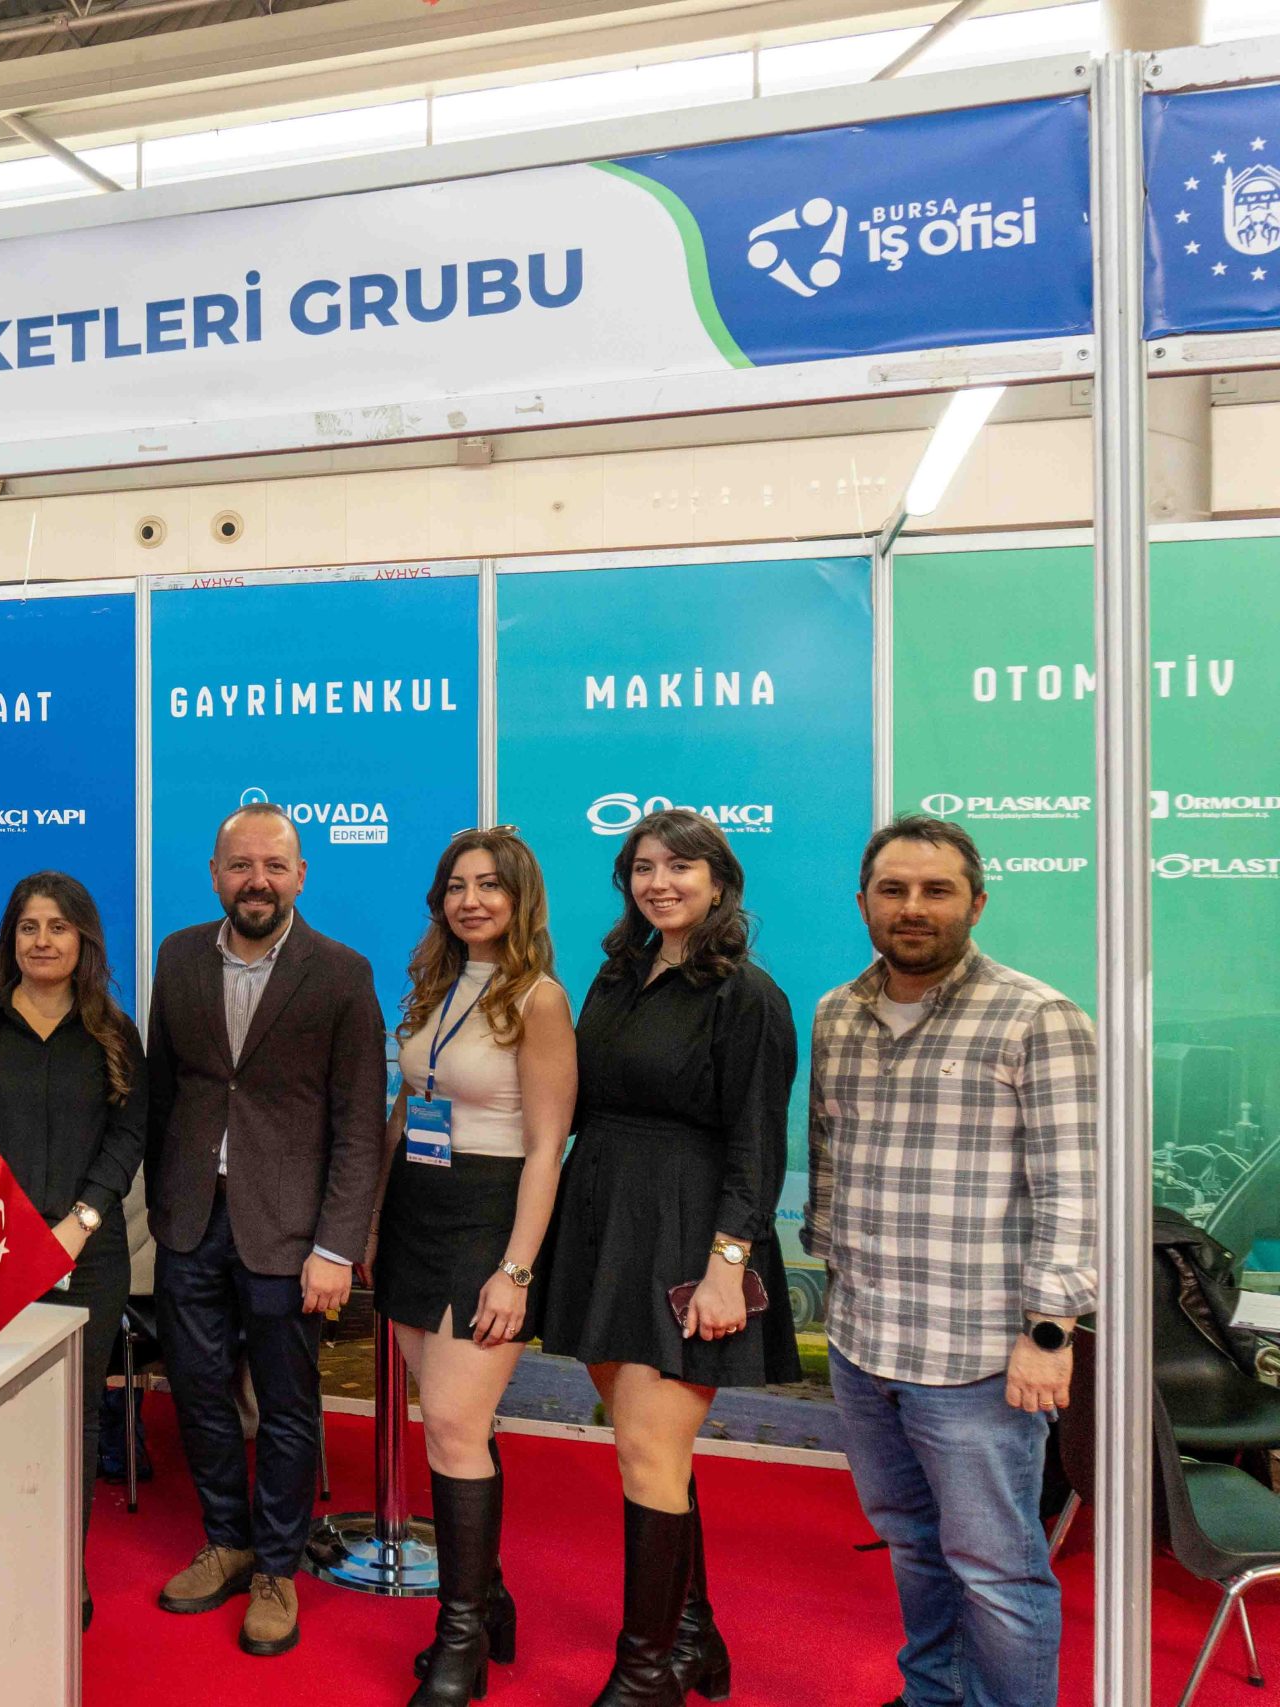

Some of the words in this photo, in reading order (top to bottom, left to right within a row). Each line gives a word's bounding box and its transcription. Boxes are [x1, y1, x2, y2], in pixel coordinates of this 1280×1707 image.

[873, 198, 957, 223] BURSA
[919, 197, 1036, 256] ofisi
[289, 247, 584, 336] GRUBU
[375, 567, 431, 580] SARAY
[586, 667, 774, 709] MAKİNA
[973, 654, 1234, 701] OTOMTİV
[170, 678, 457, 718] GAYRİMENKUL
[643, 796, 773, 826] OAKÇI
[967, 795, 1091, 811] PLASKAR
[1175, 793, 1280, 810] ORMOLD
[33, 809, 86, 825] YAPI
[333, 829, 386, 841] EDREMİT
[1005, 857, 1089, 872] GROUP
